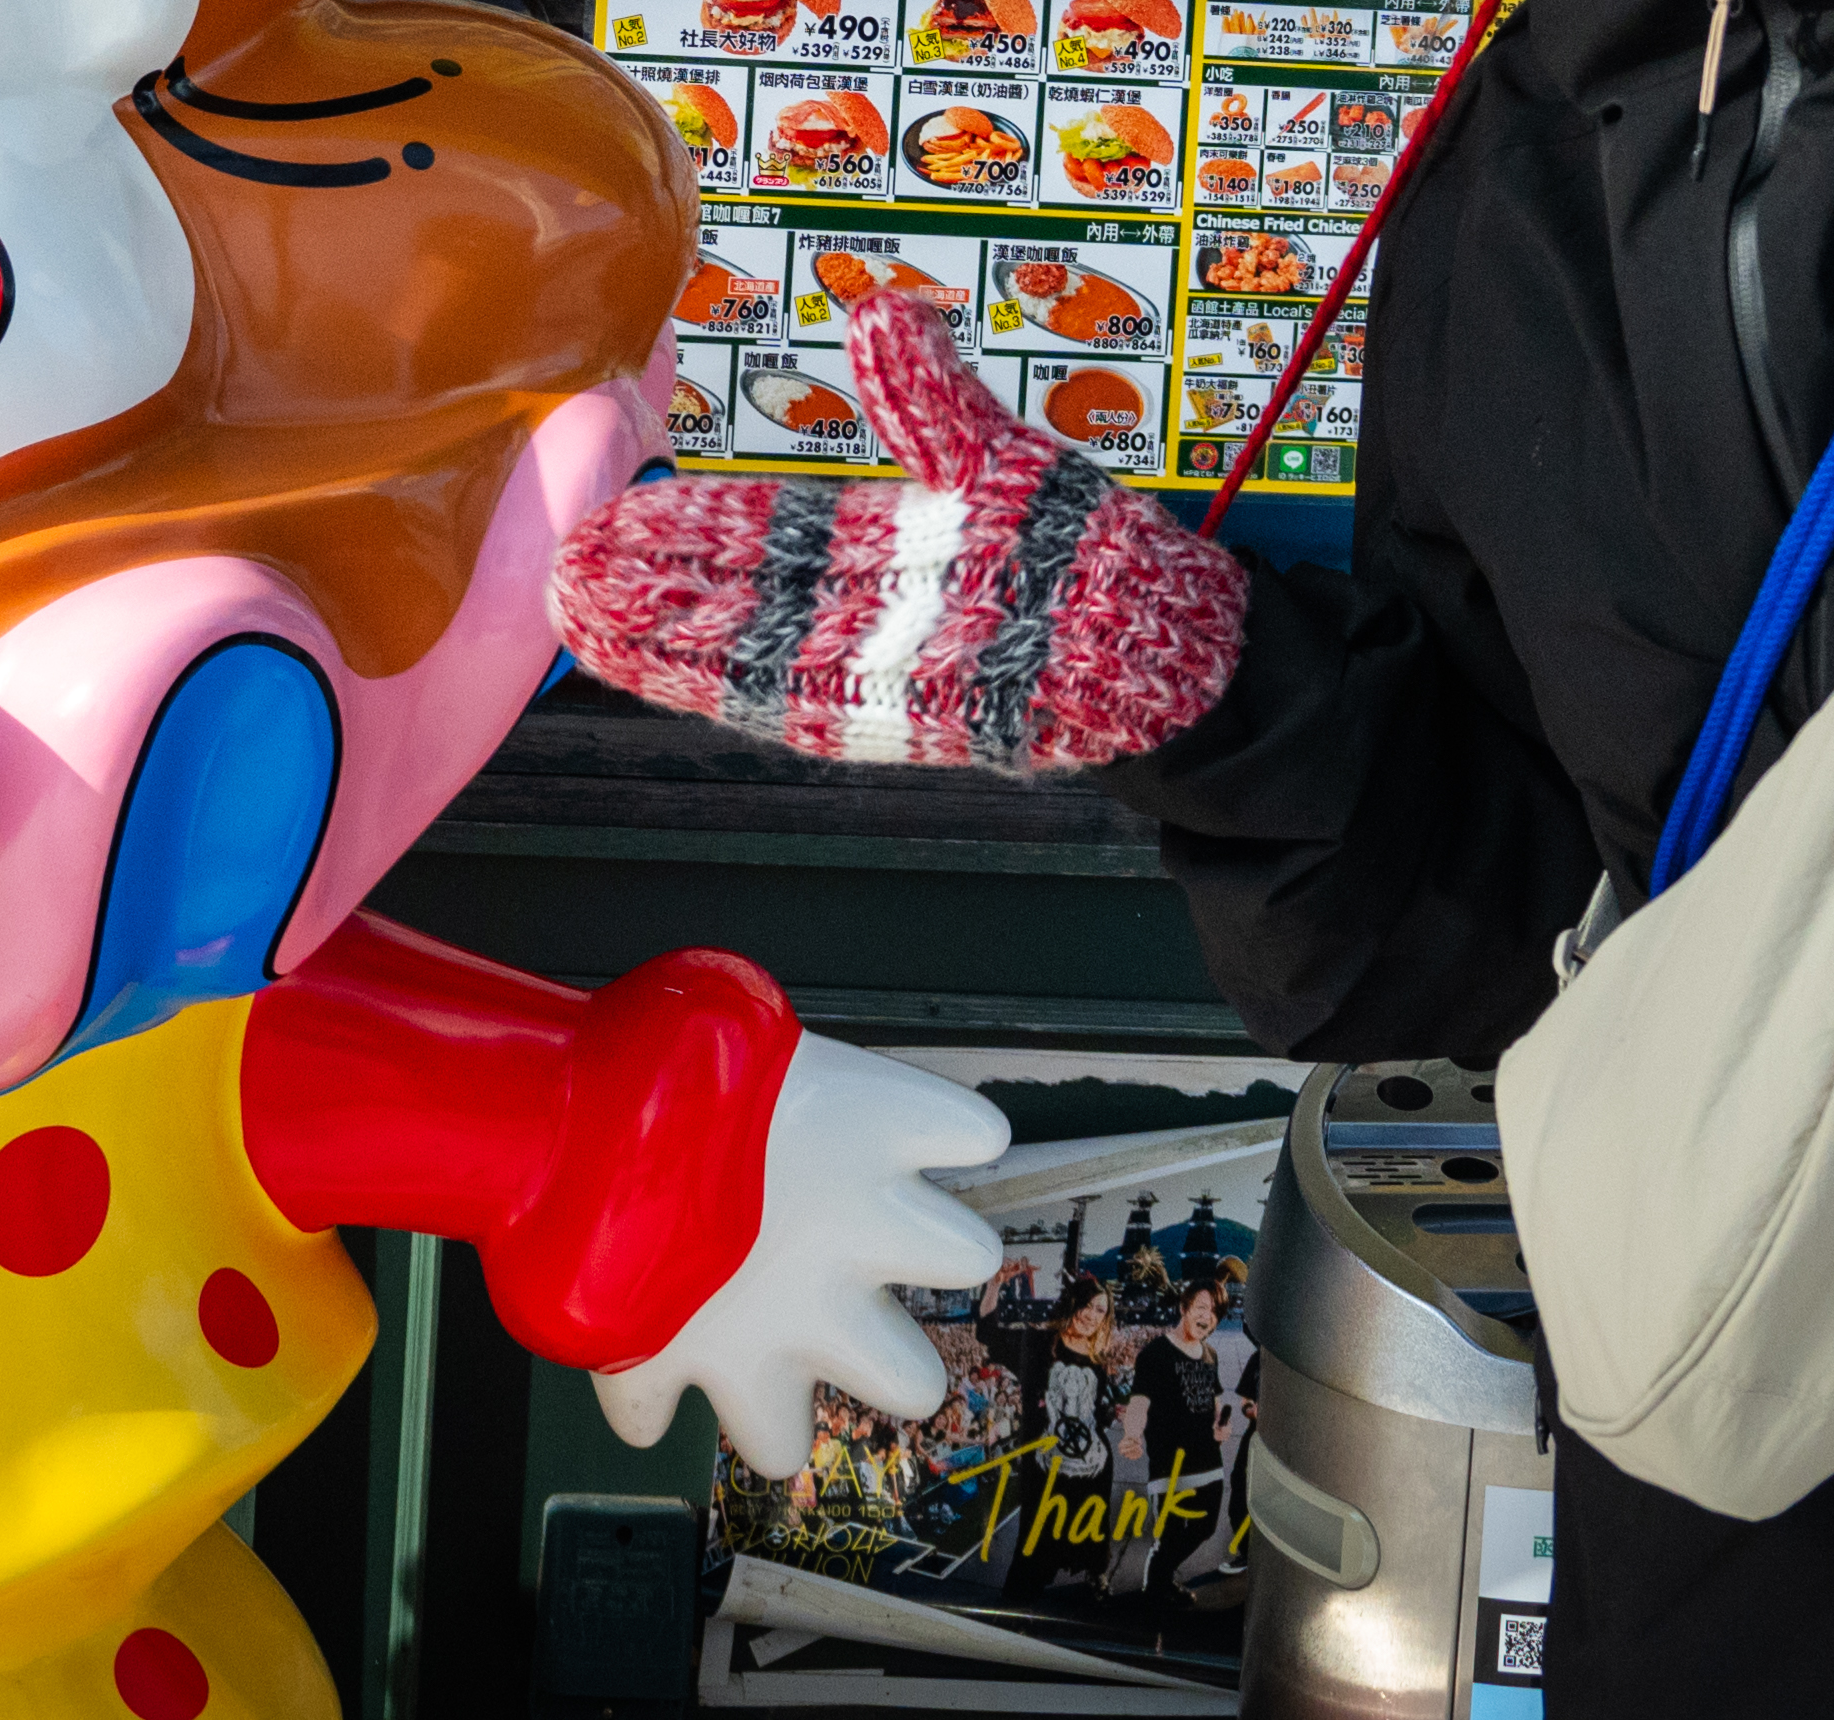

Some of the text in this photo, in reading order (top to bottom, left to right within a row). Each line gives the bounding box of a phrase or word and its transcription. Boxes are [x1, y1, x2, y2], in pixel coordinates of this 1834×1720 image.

[804, 15, 879, 42] ¥490
[680, 29, 777, 53] 社長大好物
[1206, 66, 1234, 82] 小吃
[1197, 213, 1260, 231] Chinese
[1264, 216, 1303, 233] Fried
[947, 1436, 1208, 1563] Thank
